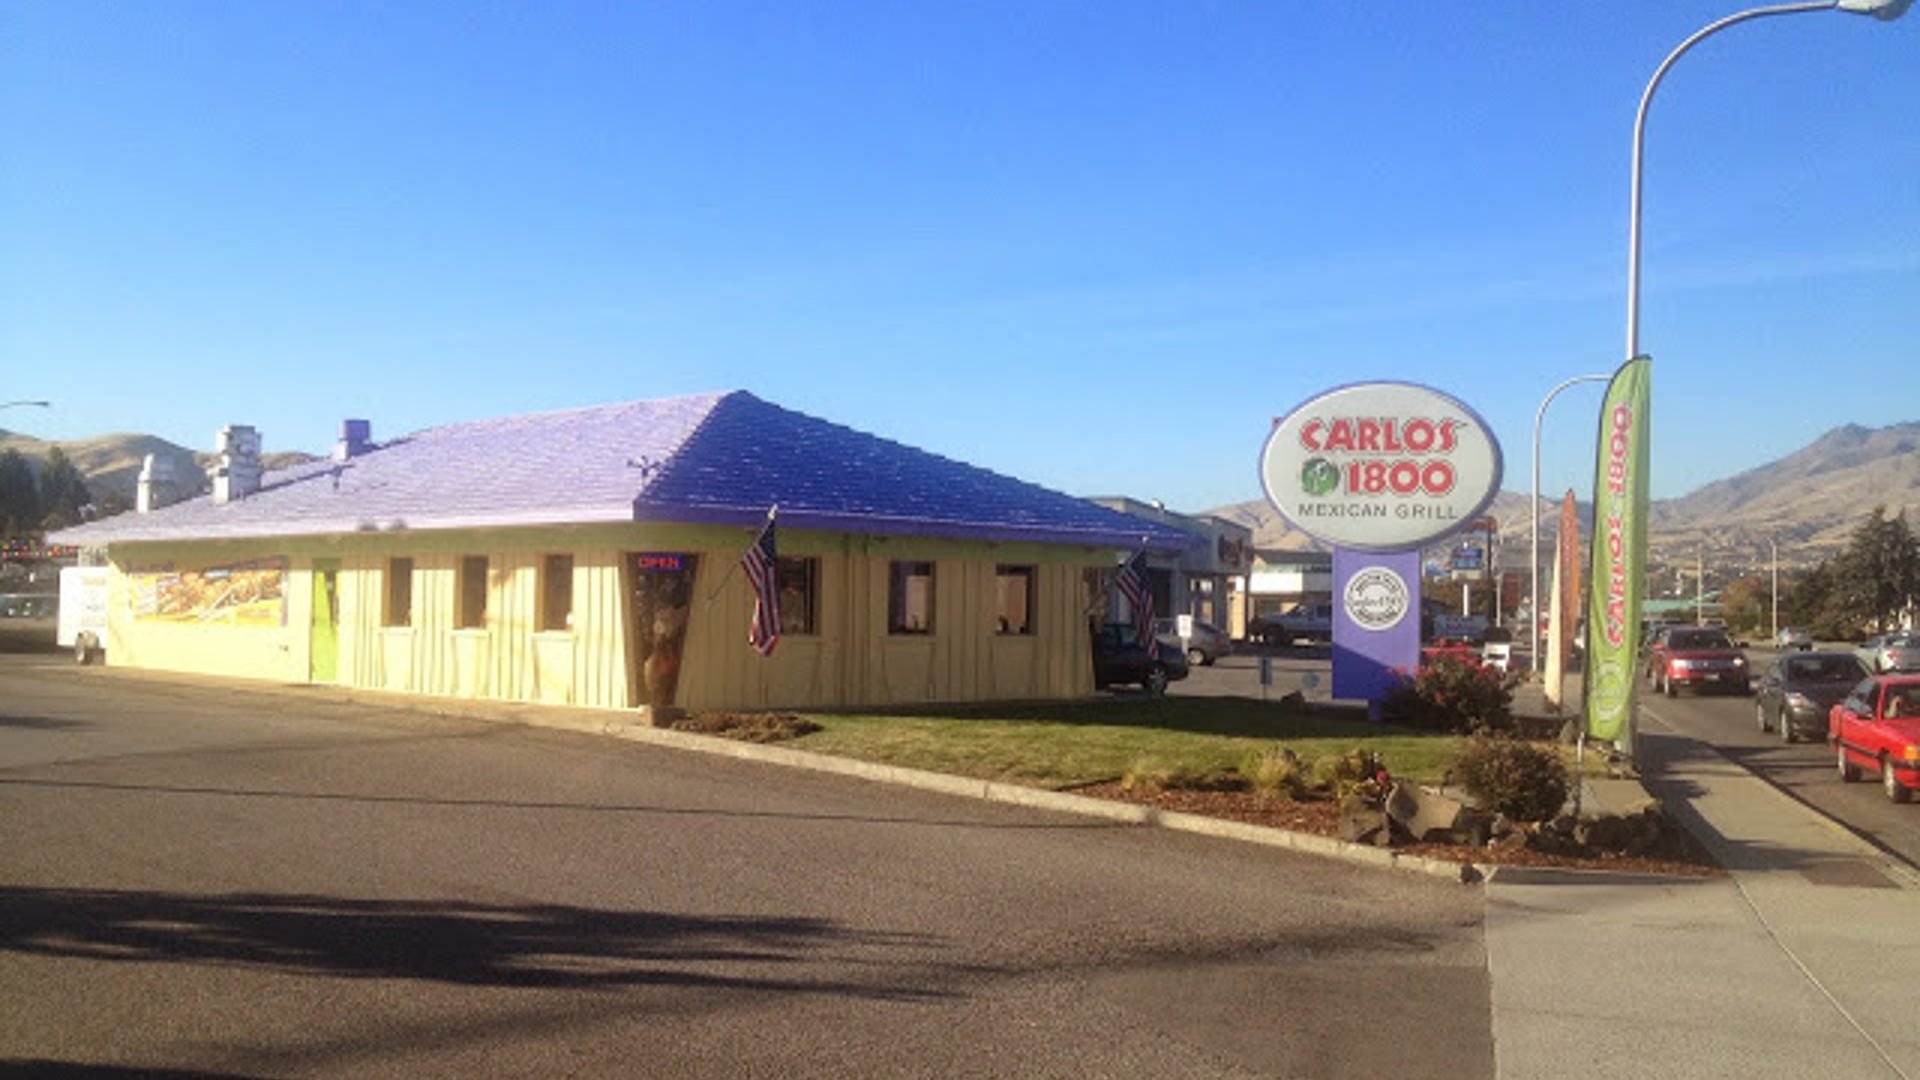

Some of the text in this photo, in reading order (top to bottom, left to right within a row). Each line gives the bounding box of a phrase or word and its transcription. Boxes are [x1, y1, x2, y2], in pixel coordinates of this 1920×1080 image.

[1300, 417, 1463, 454] CARLOS
[1607, 404, 1633, 495] 1800
[1344, 459, 1456, 496] 1800
[1298, 503, 1458, 520] MEXICAN GRILL
[639, 557, 679, 569] OPEN
[1606, 516, 1625, 645] CARLOS
